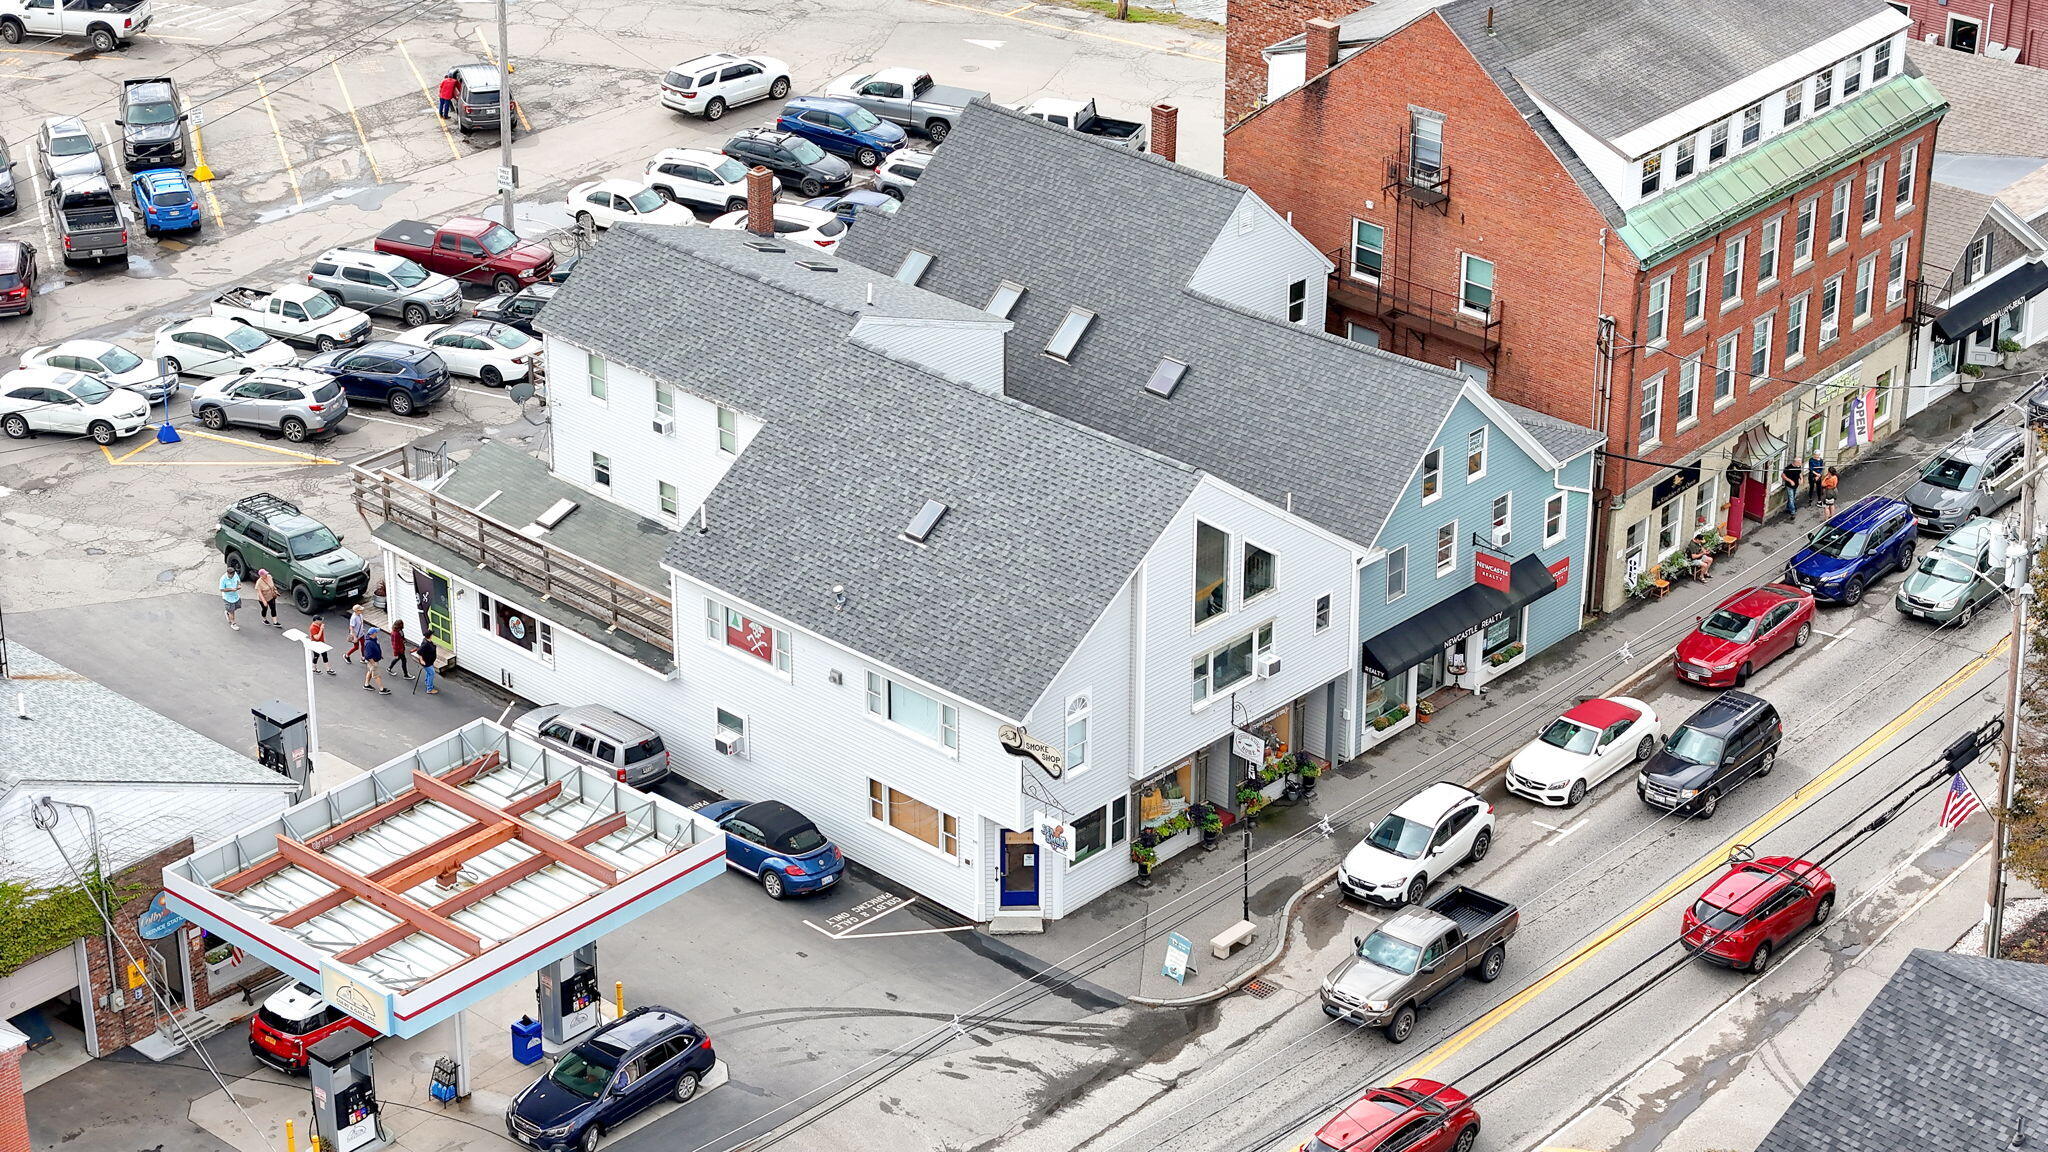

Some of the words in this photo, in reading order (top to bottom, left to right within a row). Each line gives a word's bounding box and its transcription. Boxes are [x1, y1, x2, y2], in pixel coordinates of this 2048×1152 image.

[1855, 400, 1866, 435] OPEN
[1476, 560, 1509, 577] NEWCASTLE
[1482, 571, 1503, 582] REALTY
[1444, 625, 1478, 648] NEWCASTLE
[1481, 611, 1503, 628] REALTY
[1364, 666, 1385, 678] REALTY
[1025, 742, 1049, 754] SMOKE
[1041, 753, 1061, 764] SHOP
[851, 891, 893, 913] PARKING
[872, 896, 902, 913] COLBY
[825, 911, 851, 926] ONLY
[832, 916, 859, 931] GALE
[145, 924, 166, 937] SERVICE
